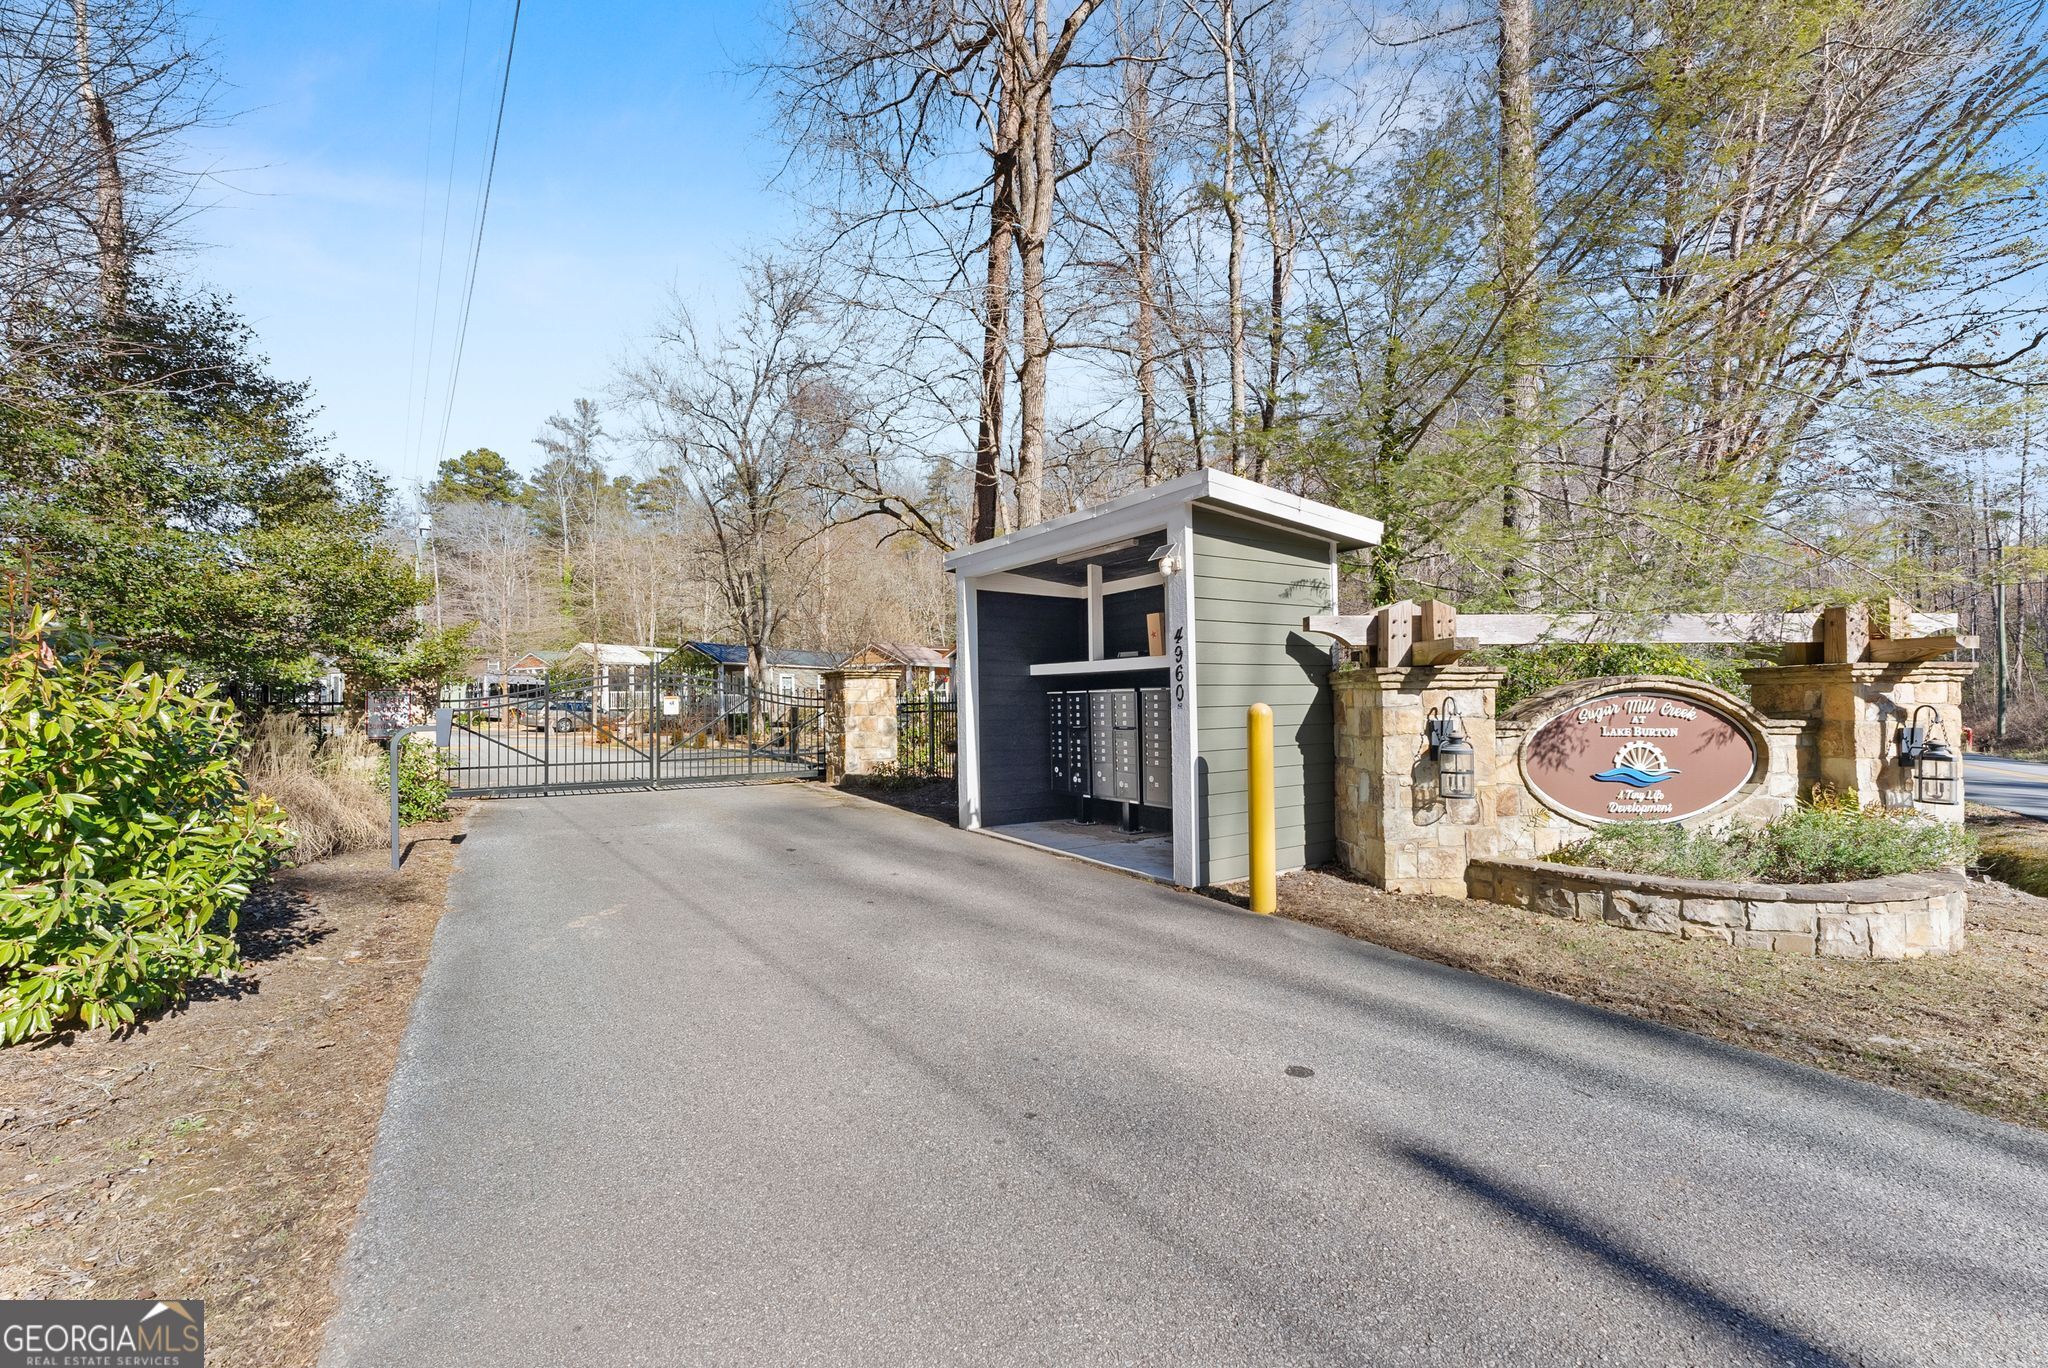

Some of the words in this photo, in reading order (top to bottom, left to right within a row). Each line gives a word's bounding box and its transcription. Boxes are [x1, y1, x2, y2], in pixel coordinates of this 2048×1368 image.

[1173, 626, 1185, 702] 4960
[1577, 703, 1621, 724] Sugar
[1623, 698, 1657, 715] Mill
[1660, 701, 1698, 721] Creek
[1630, 715, 1647, 725] AT
[1602, 725, 1632, 737] LAKE
[1633, 725, 1679, 738] BURTON
[1625, 789, 1646, 802] Tiny
[1647, 789, 1665, 802] Life
[1607, 801, 1673, 816] Development
